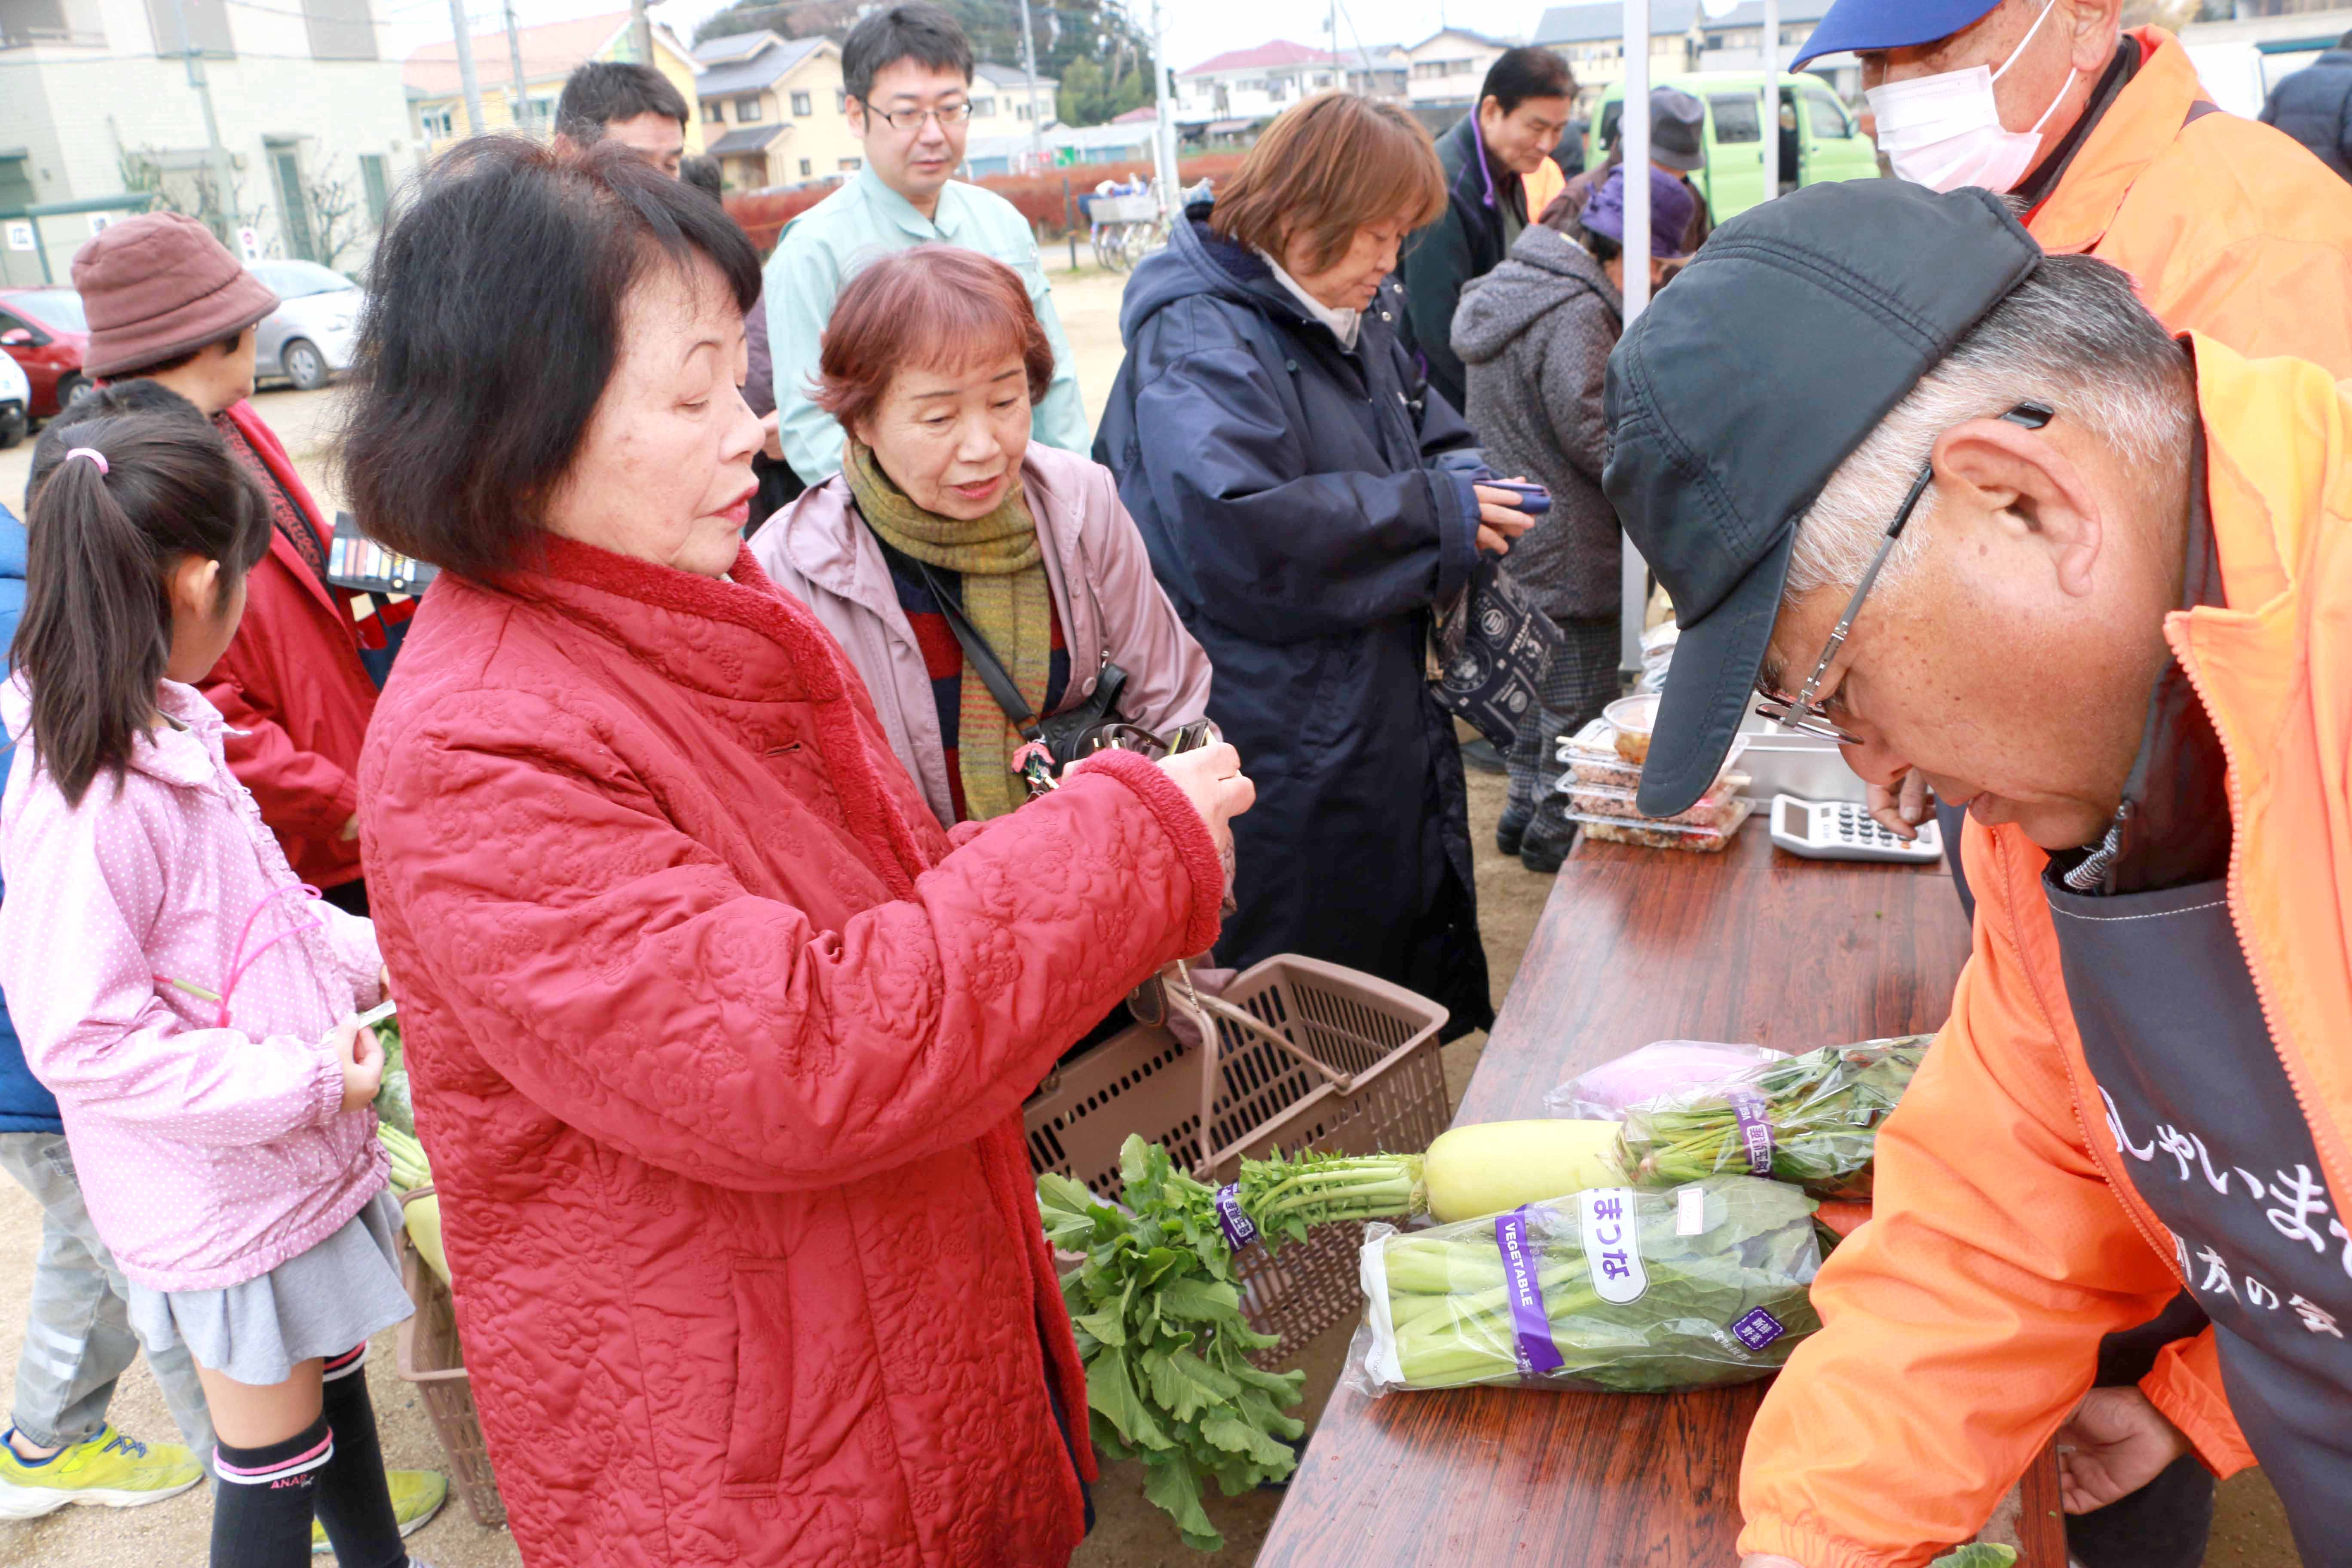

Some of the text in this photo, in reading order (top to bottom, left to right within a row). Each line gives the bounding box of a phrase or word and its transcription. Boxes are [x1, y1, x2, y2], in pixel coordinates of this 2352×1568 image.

[1504, 1222, 1534, 1307] VEGETABLE
[1593, 1187, 1630, 1281] まつな
